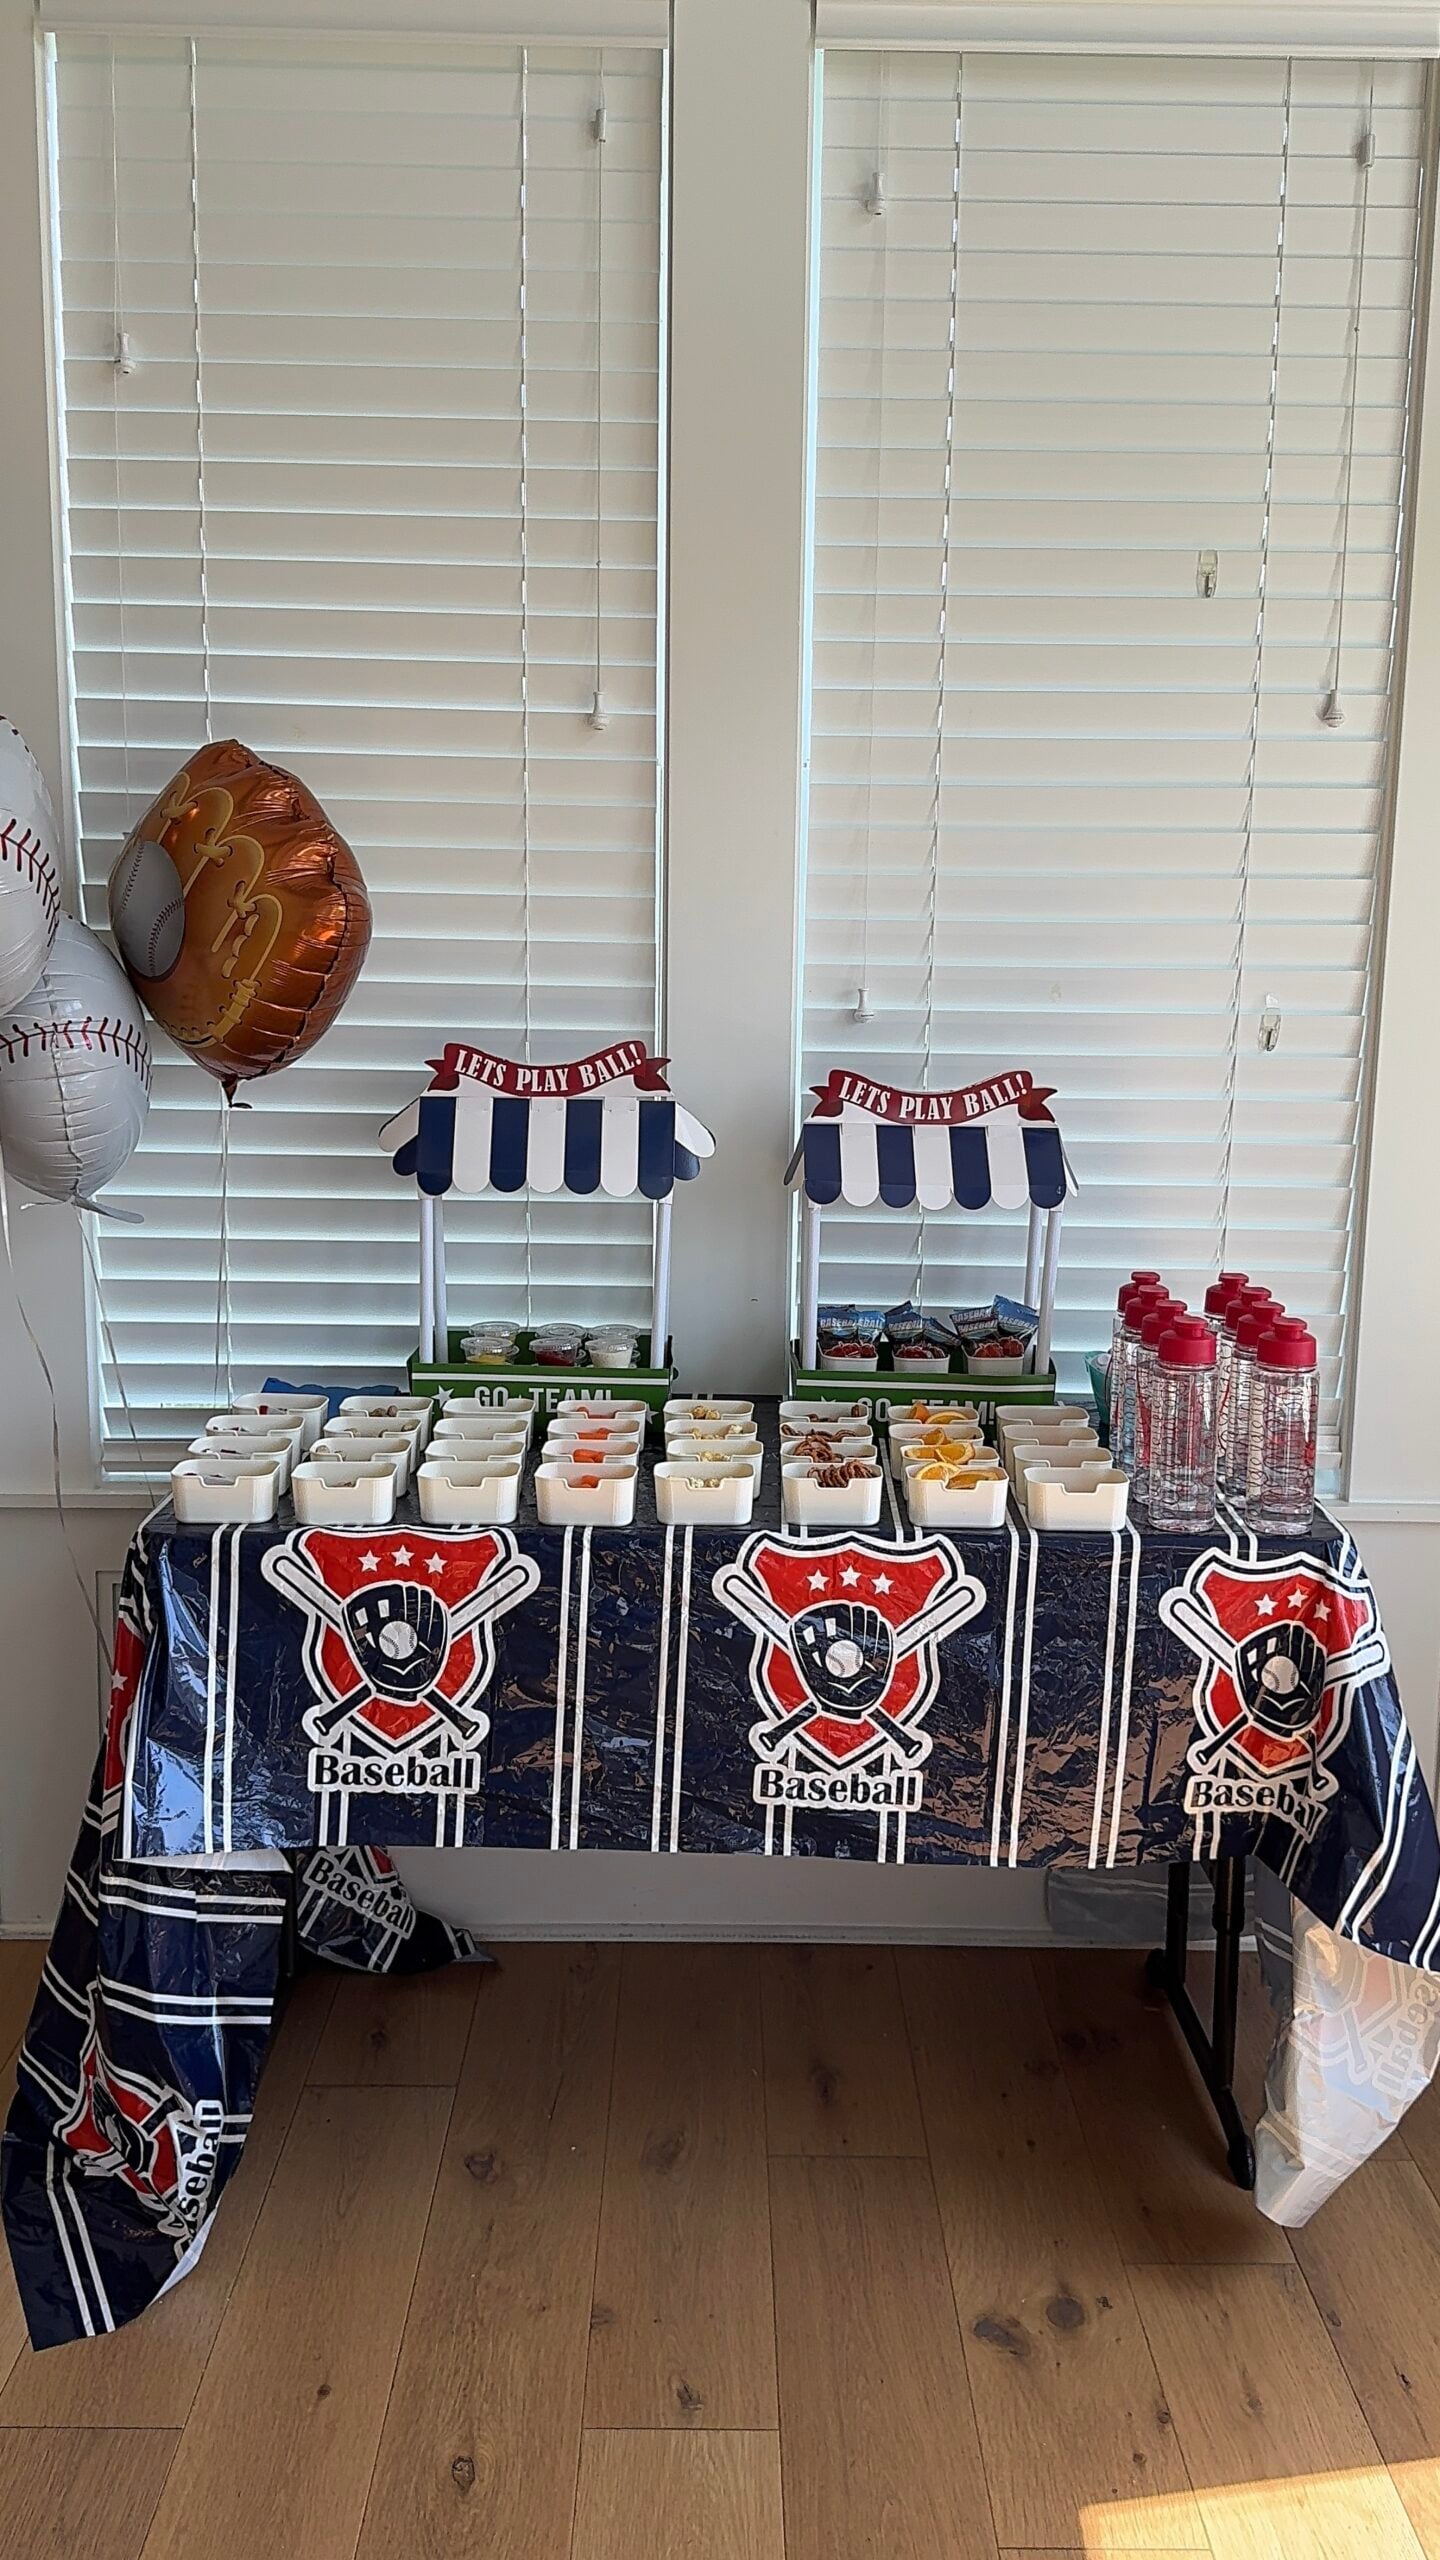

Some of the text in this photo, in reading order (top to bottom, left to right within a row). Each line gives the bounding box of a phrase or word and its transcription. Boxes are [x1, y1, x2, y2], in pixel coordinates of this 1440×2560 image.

[454, 1043, 642, 1092] LETS PLAY BALL!
[838, 1073, 1028, 1121] LETS PLAY BALL!
[474, 1386, 509, 1408] GO
[314, 1754, 475, 1789] Baseball
[759, 1768, 917, 1806] Baseball
[308, 1856, 415, 1934] Baseball
[178, 2107, 223, 2240] seball
